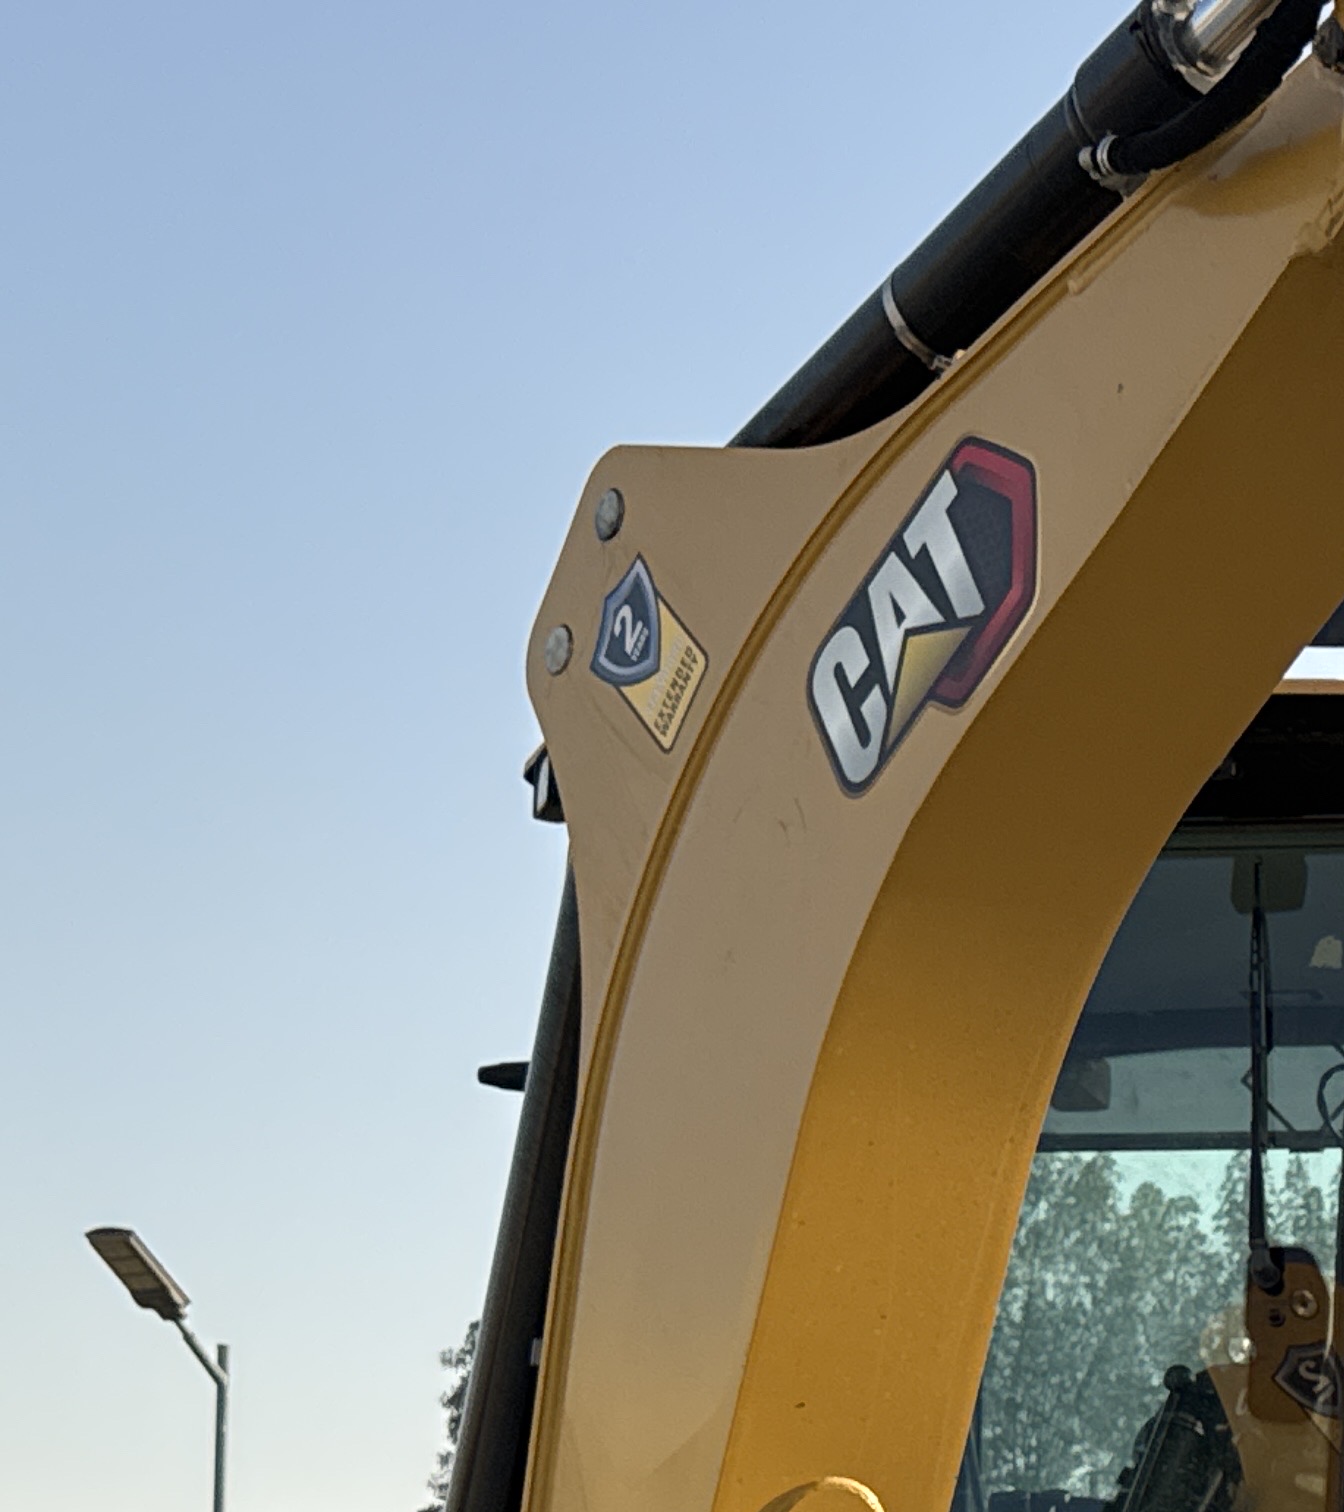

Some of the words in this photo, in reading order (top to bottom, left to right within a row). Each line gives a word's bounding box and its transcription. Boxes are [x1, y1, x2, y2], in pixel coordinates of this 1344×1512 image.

[614, 604, 643, 656] 2
[812, 469, 986, 784] CAT
[653, 645, 694, 731] EXTENDED
[660, 653, 699, 737] WARRANTY
